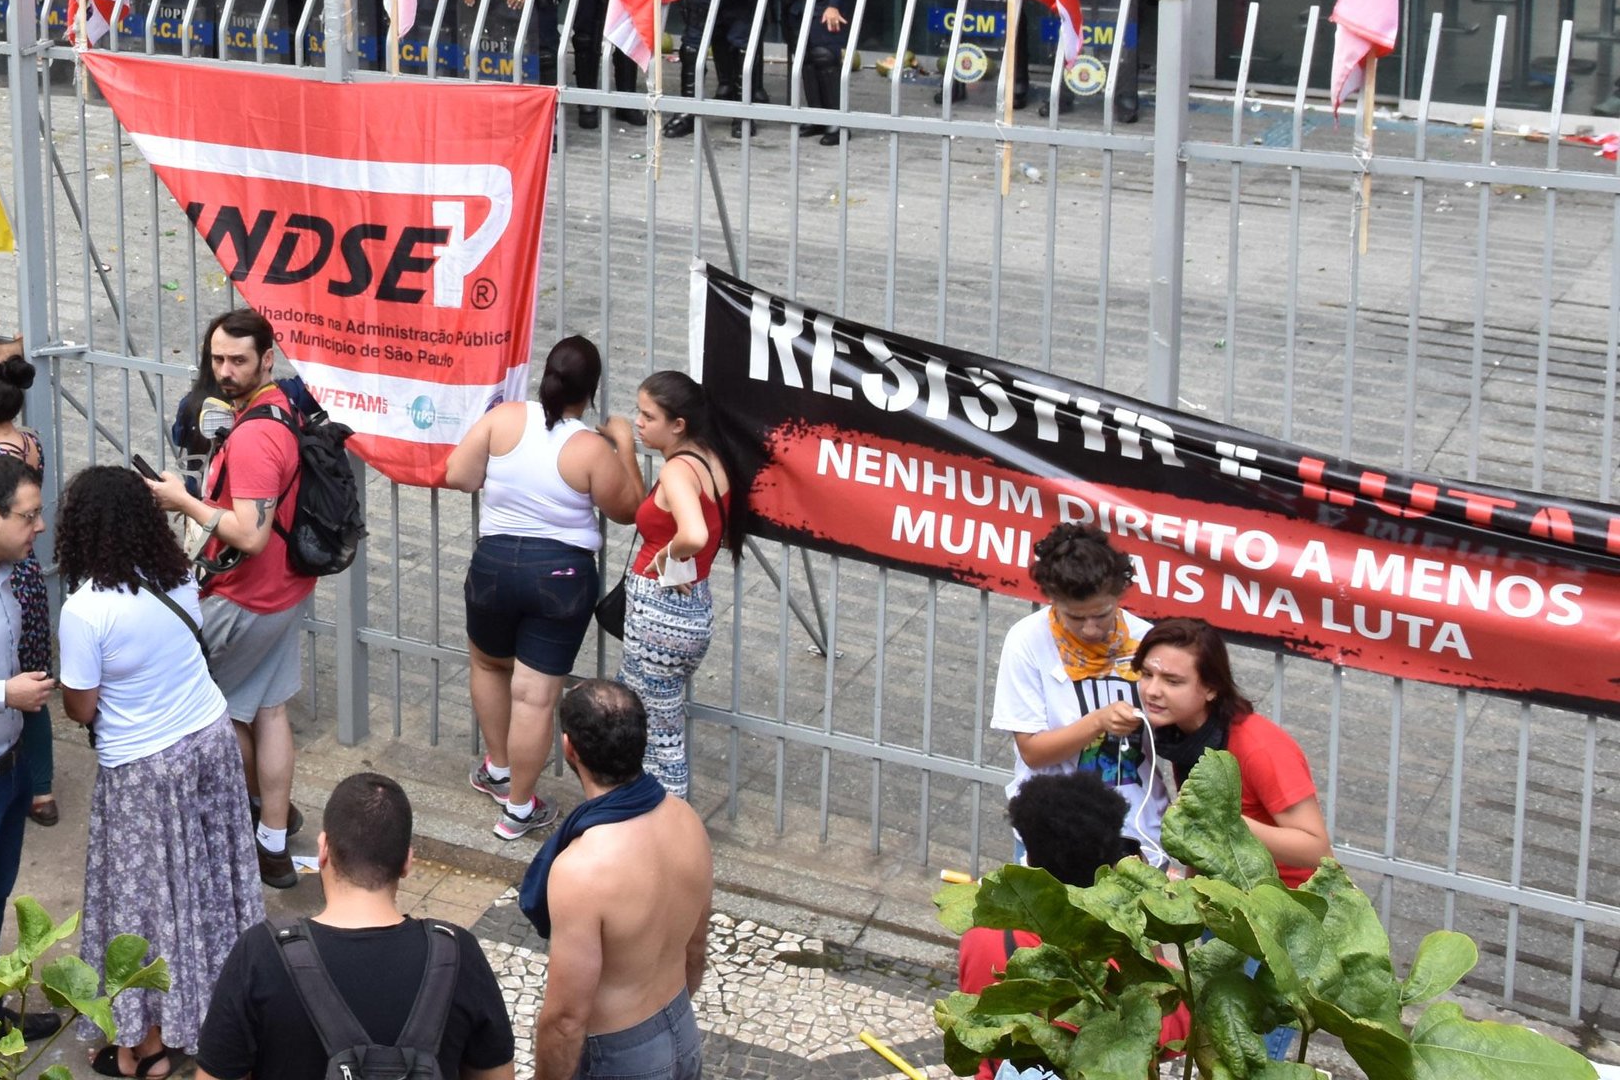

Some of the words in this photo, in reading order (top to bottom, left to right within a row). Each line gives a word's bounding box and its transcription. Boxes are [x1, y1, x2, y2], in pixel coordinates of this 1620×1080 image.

[944, 12, 996, 34] GCM
[256, 305, 325, 326] lhadores
[346, 320, 454, 347] Administração
[456, 330, 512, 348] Pública
[290, 330, 356, 355] Município
[360, 344, 380, 358] de
[384, 347, 413, 362] São
[418, 350, 454, 368] Paulo
[305, 383, 381, 415] NFETAM
[749, 290, 1186, 469] RESISTIR
[816, 438, 1044, 519] NENHUM
[1058, 492, 1279, 572] DIREITO
[1291, 539, 1334, 584] A
[1350, 547, 1585, 627] MENOS
[1220, 573, 1305, 625] NA
[1321, 597, 1474, 661] LUTA
